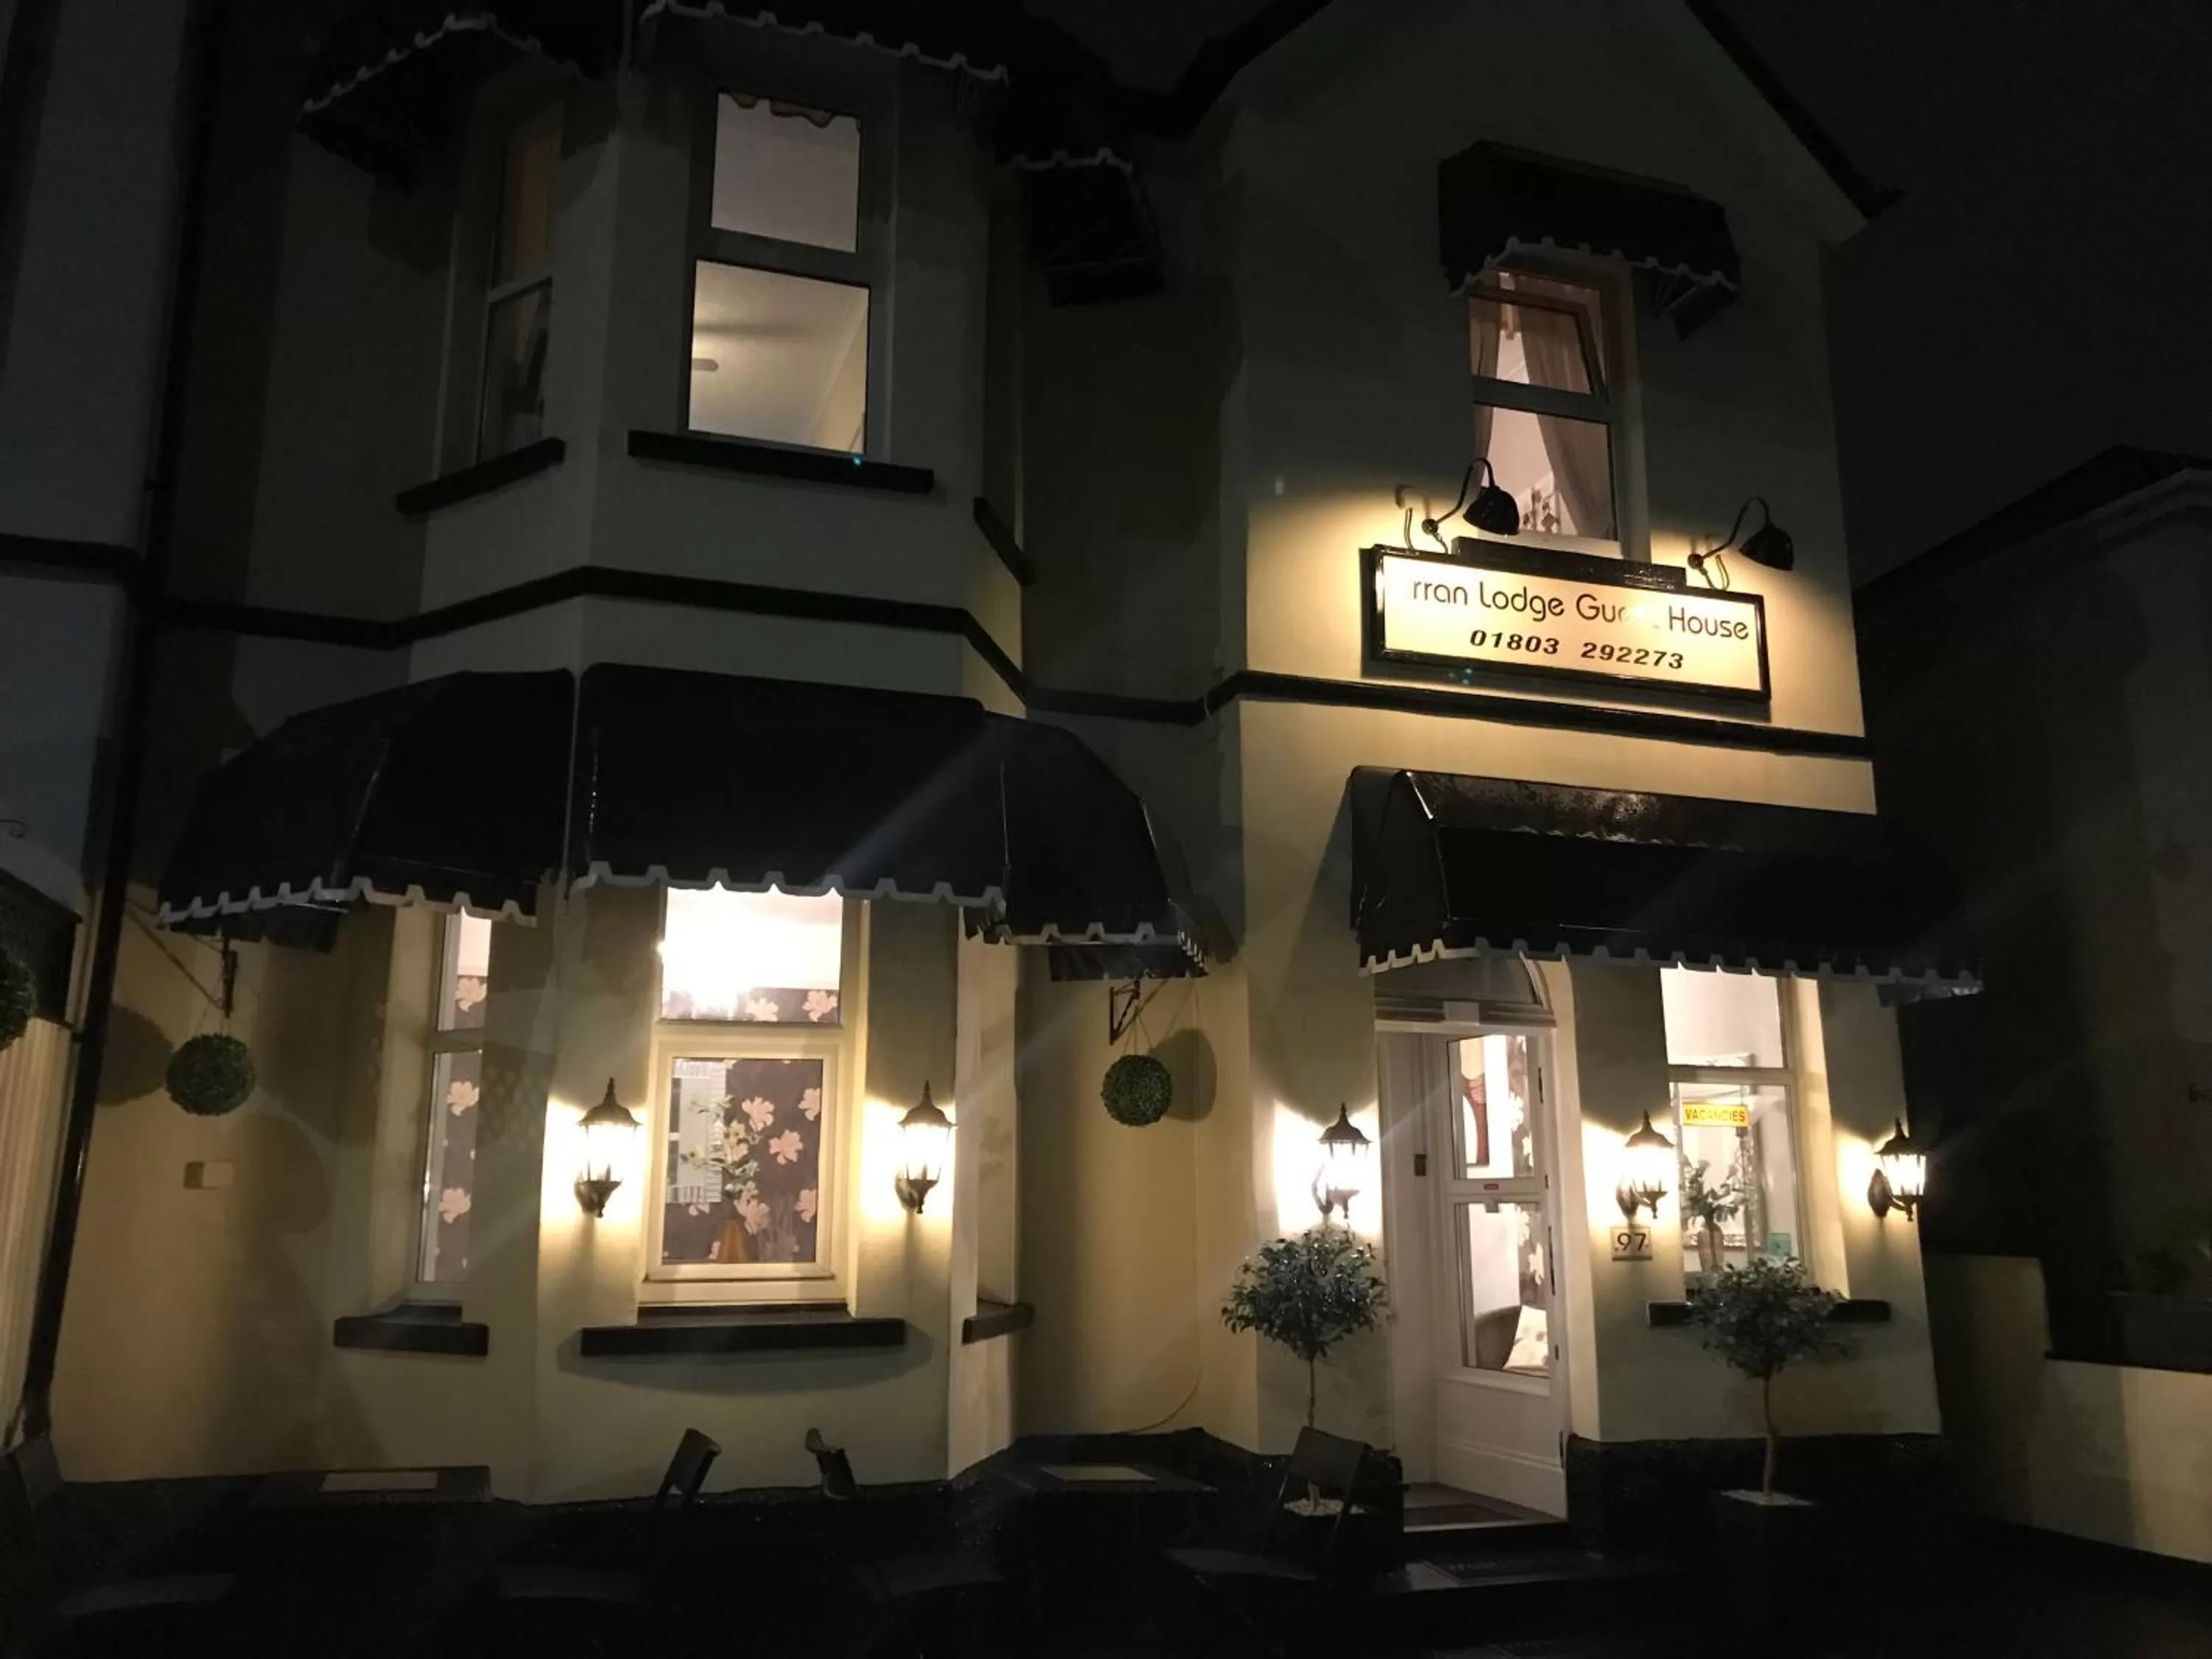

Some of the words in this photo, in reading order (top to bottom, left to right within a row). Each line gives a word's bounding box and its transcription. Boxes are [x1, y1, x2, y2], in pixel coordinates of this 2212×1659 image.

[1479, 580, 1565, 622] Lodge
[1668, 605, 1749, 640] House
[1470, 629, 1559, 655] 01803
[1581, 641, 1684, 669] 292273
[1685, 1108, 1746, 1122] VACANCIES
[1617, 1232, 1646, 1251] 97
